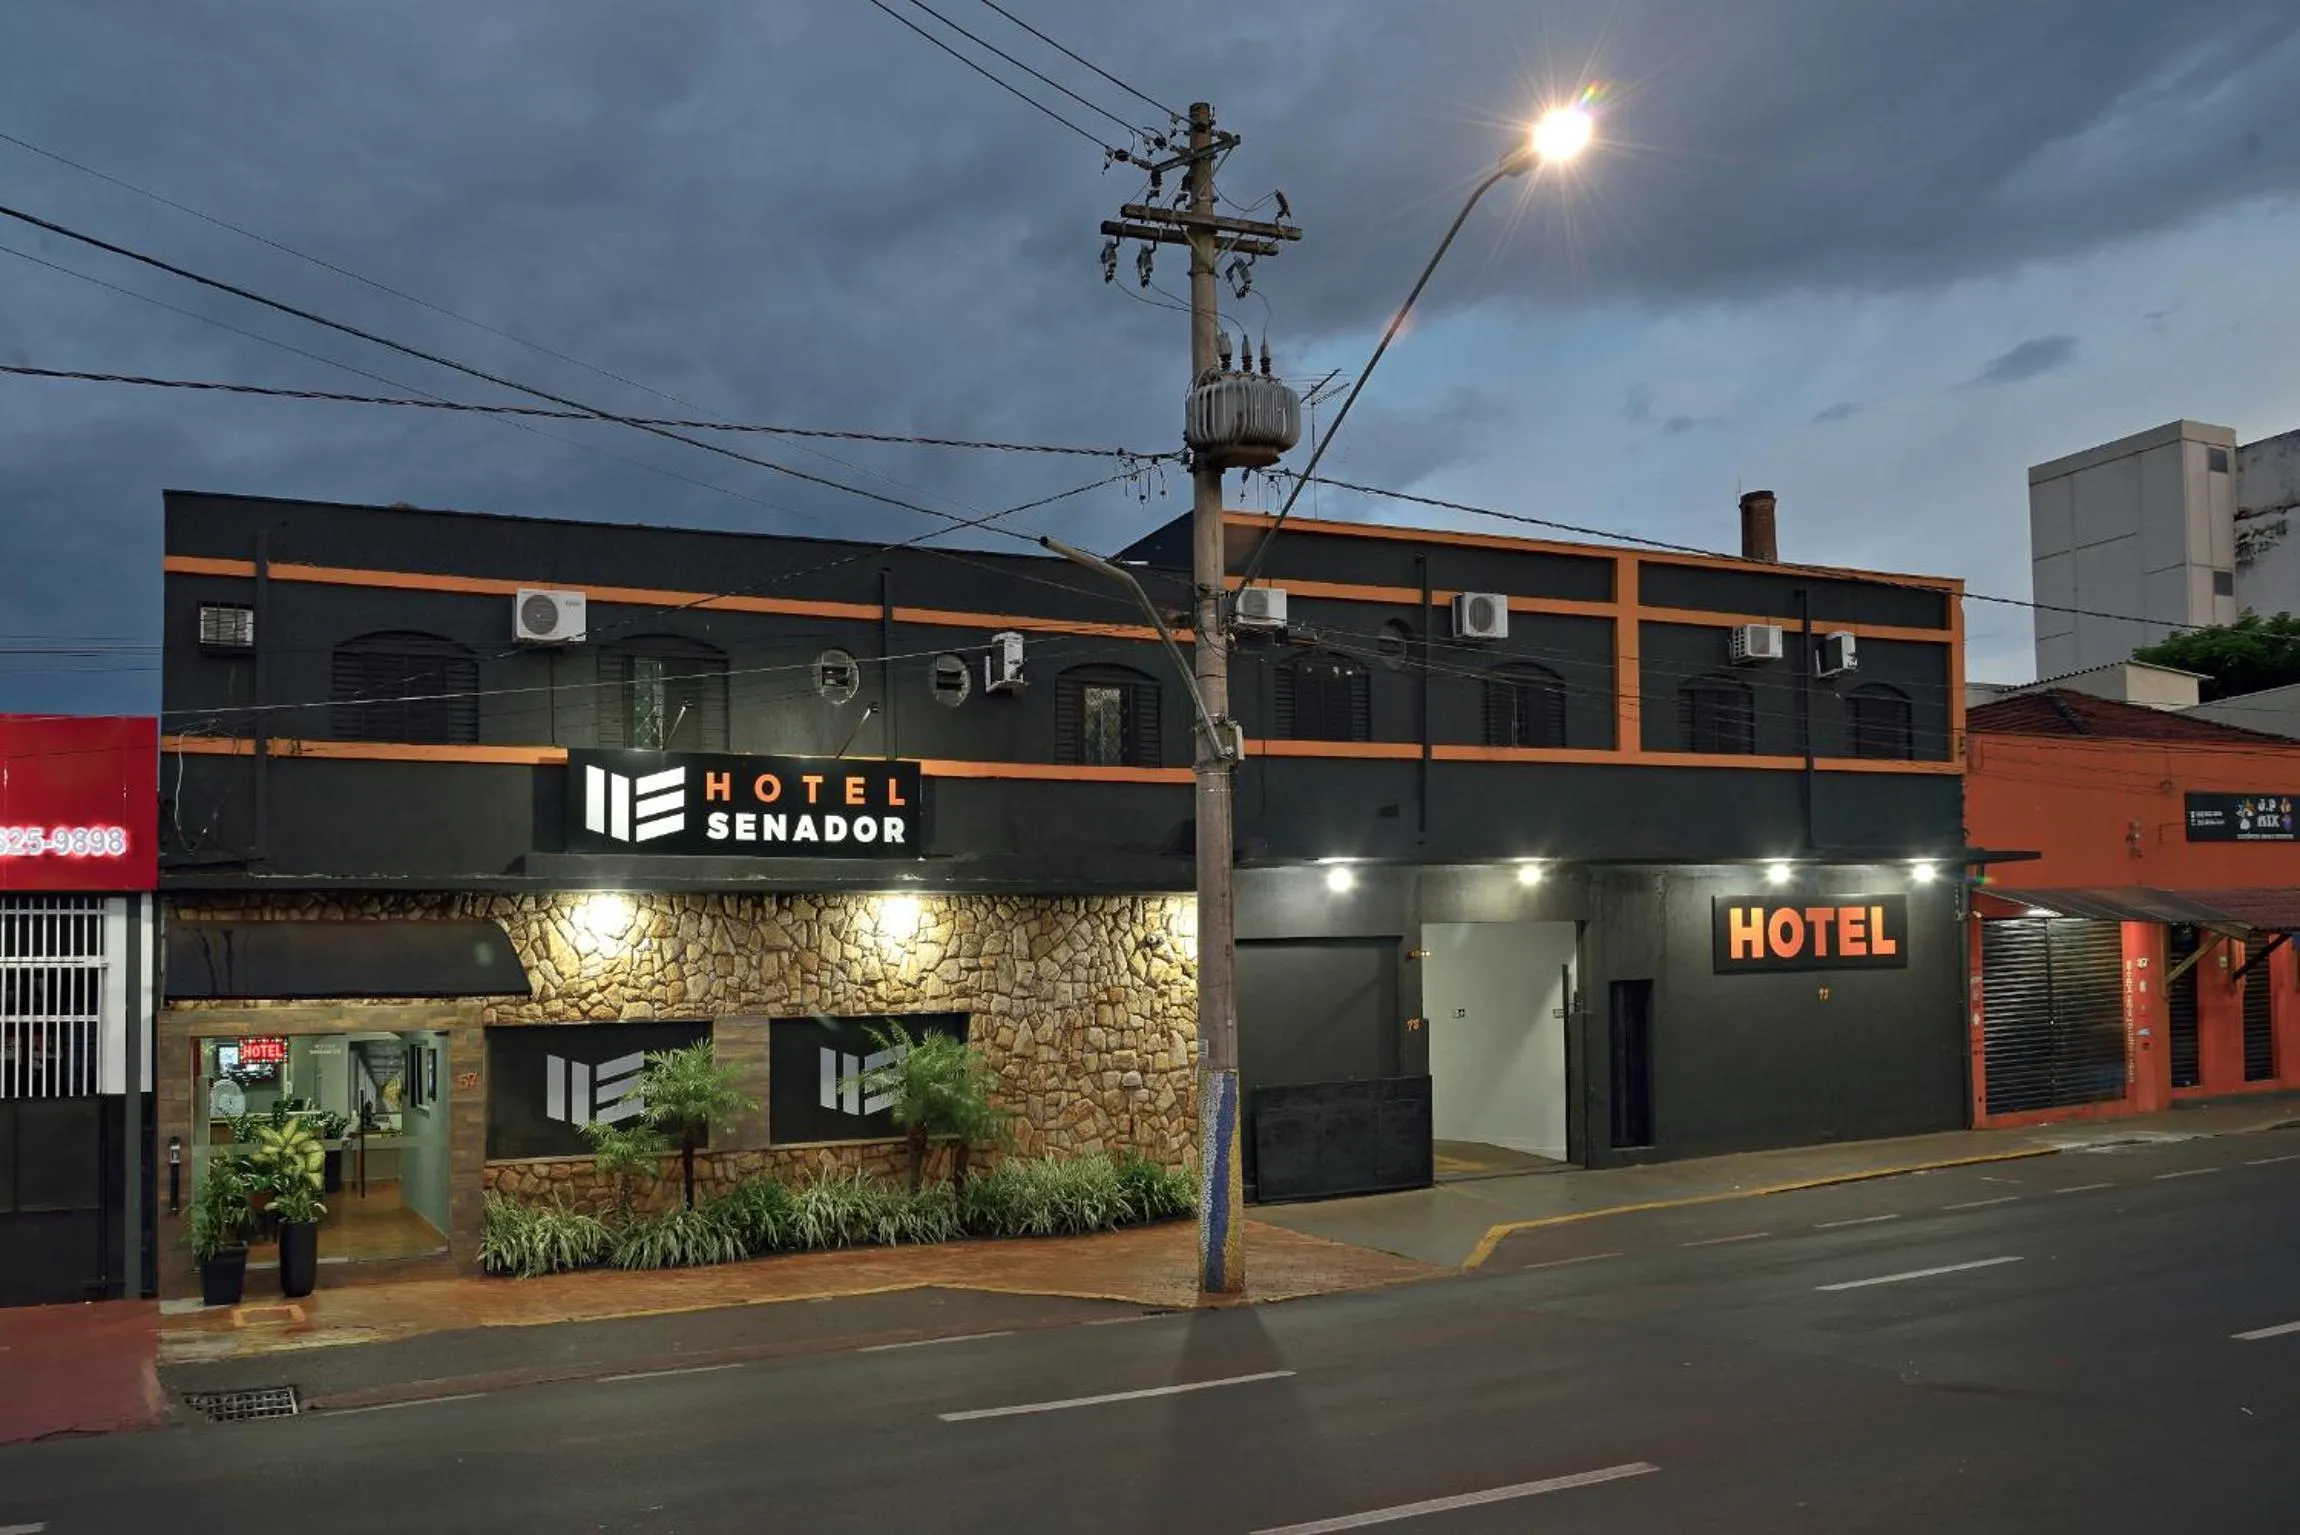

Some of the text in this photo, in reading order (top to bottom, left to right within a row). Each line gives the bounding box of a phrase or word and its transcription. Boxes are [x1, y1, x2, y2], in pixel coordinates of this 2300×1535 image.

[705, 771, 906, 806] HOTEL
[705, 811, 906, 843] SENADOR
[1729, 905, 1897, 960] HOTEL
[243, 1043, 283, 1058] HOTEL
